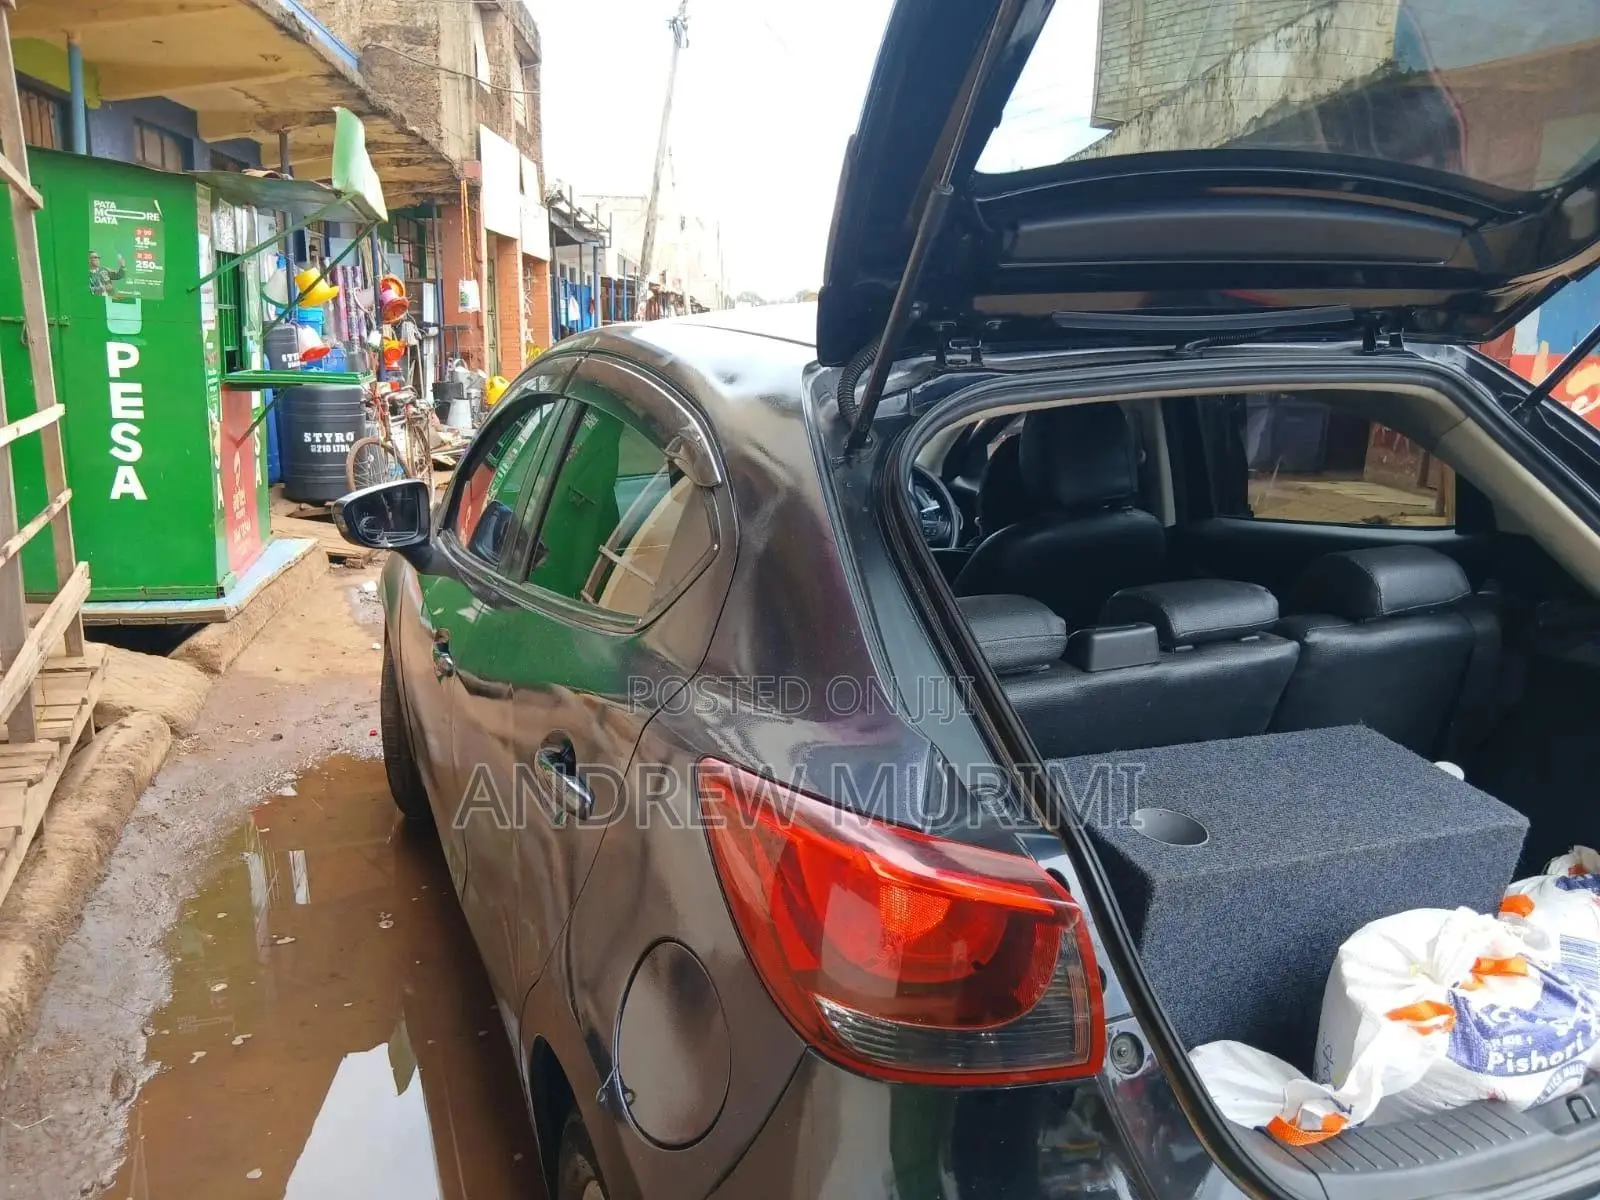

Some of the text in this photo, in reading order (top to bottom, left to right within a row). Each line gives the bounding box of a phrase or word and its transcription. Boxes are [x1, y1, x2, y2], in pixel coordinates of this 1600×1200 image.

[94, 200, 116, 209] PATA
[94, 216, 119, 225] DATA
[106, 341, 148, 500] PESA
[303, 431, 356, 443] STYRO
[1487, 1031, 1584, 1074] Pishori
